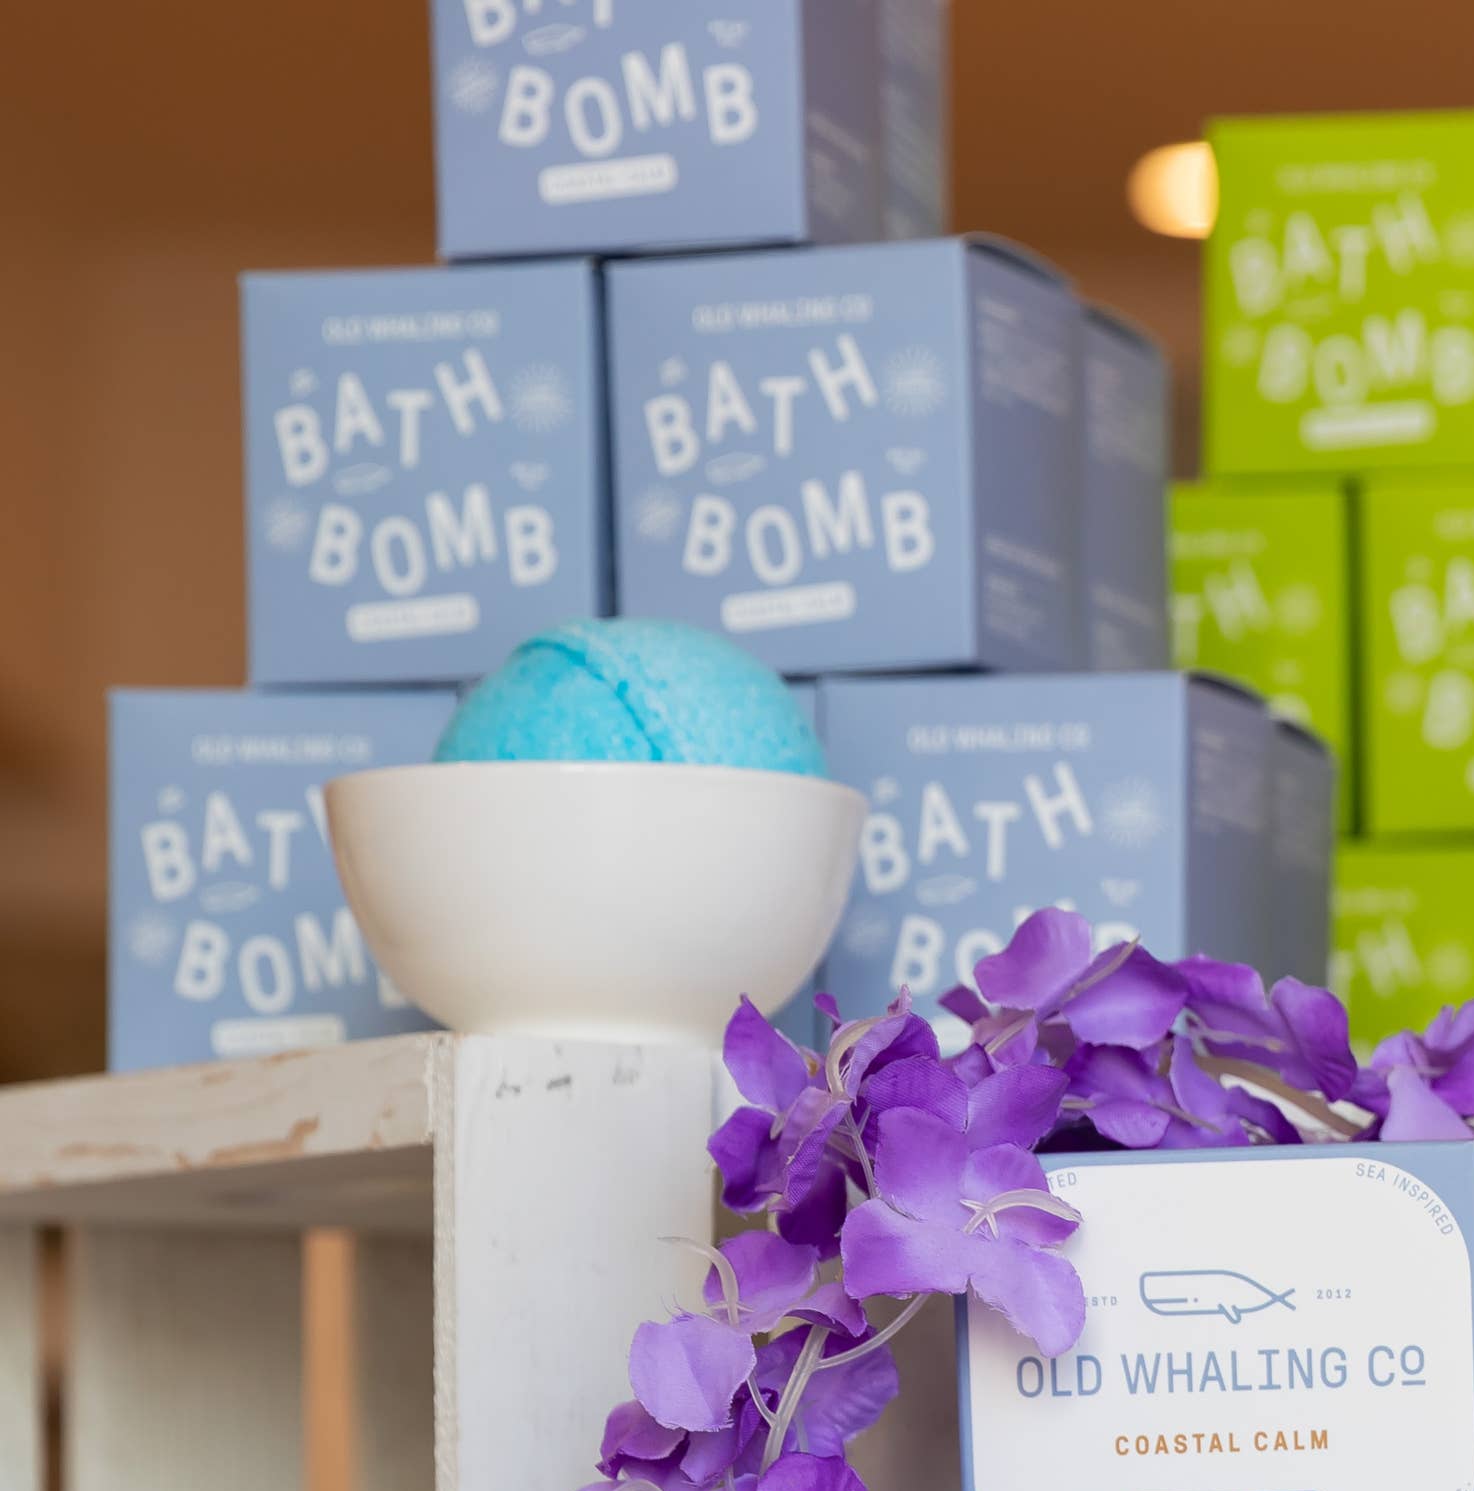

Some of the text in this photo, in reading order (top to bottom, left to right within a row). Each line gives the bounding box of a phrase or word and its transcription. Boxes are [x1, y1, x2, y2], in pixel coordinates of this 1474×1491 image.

[497, 41, 758, 158] BOMB
[273, 348, 503, 486] BATH
[644, 333, 879, 477] BATH
[308, 483, 558, 596] BOMB
[682, 470, 935, 585] BOMB
[141, 785, 328, 901] BAT
[859, 761, 1094, 894] BATH
[174, 908, 406, 1008] BOM
[1355, 1163, 1454, 1237] SEA INSPIRED
[1016, 1354, 1102, 1397] OLD
[1121, 1347, 1348, 1394] WHALING
[1115, 1430, 1329, 1456] COASTAL CALM
